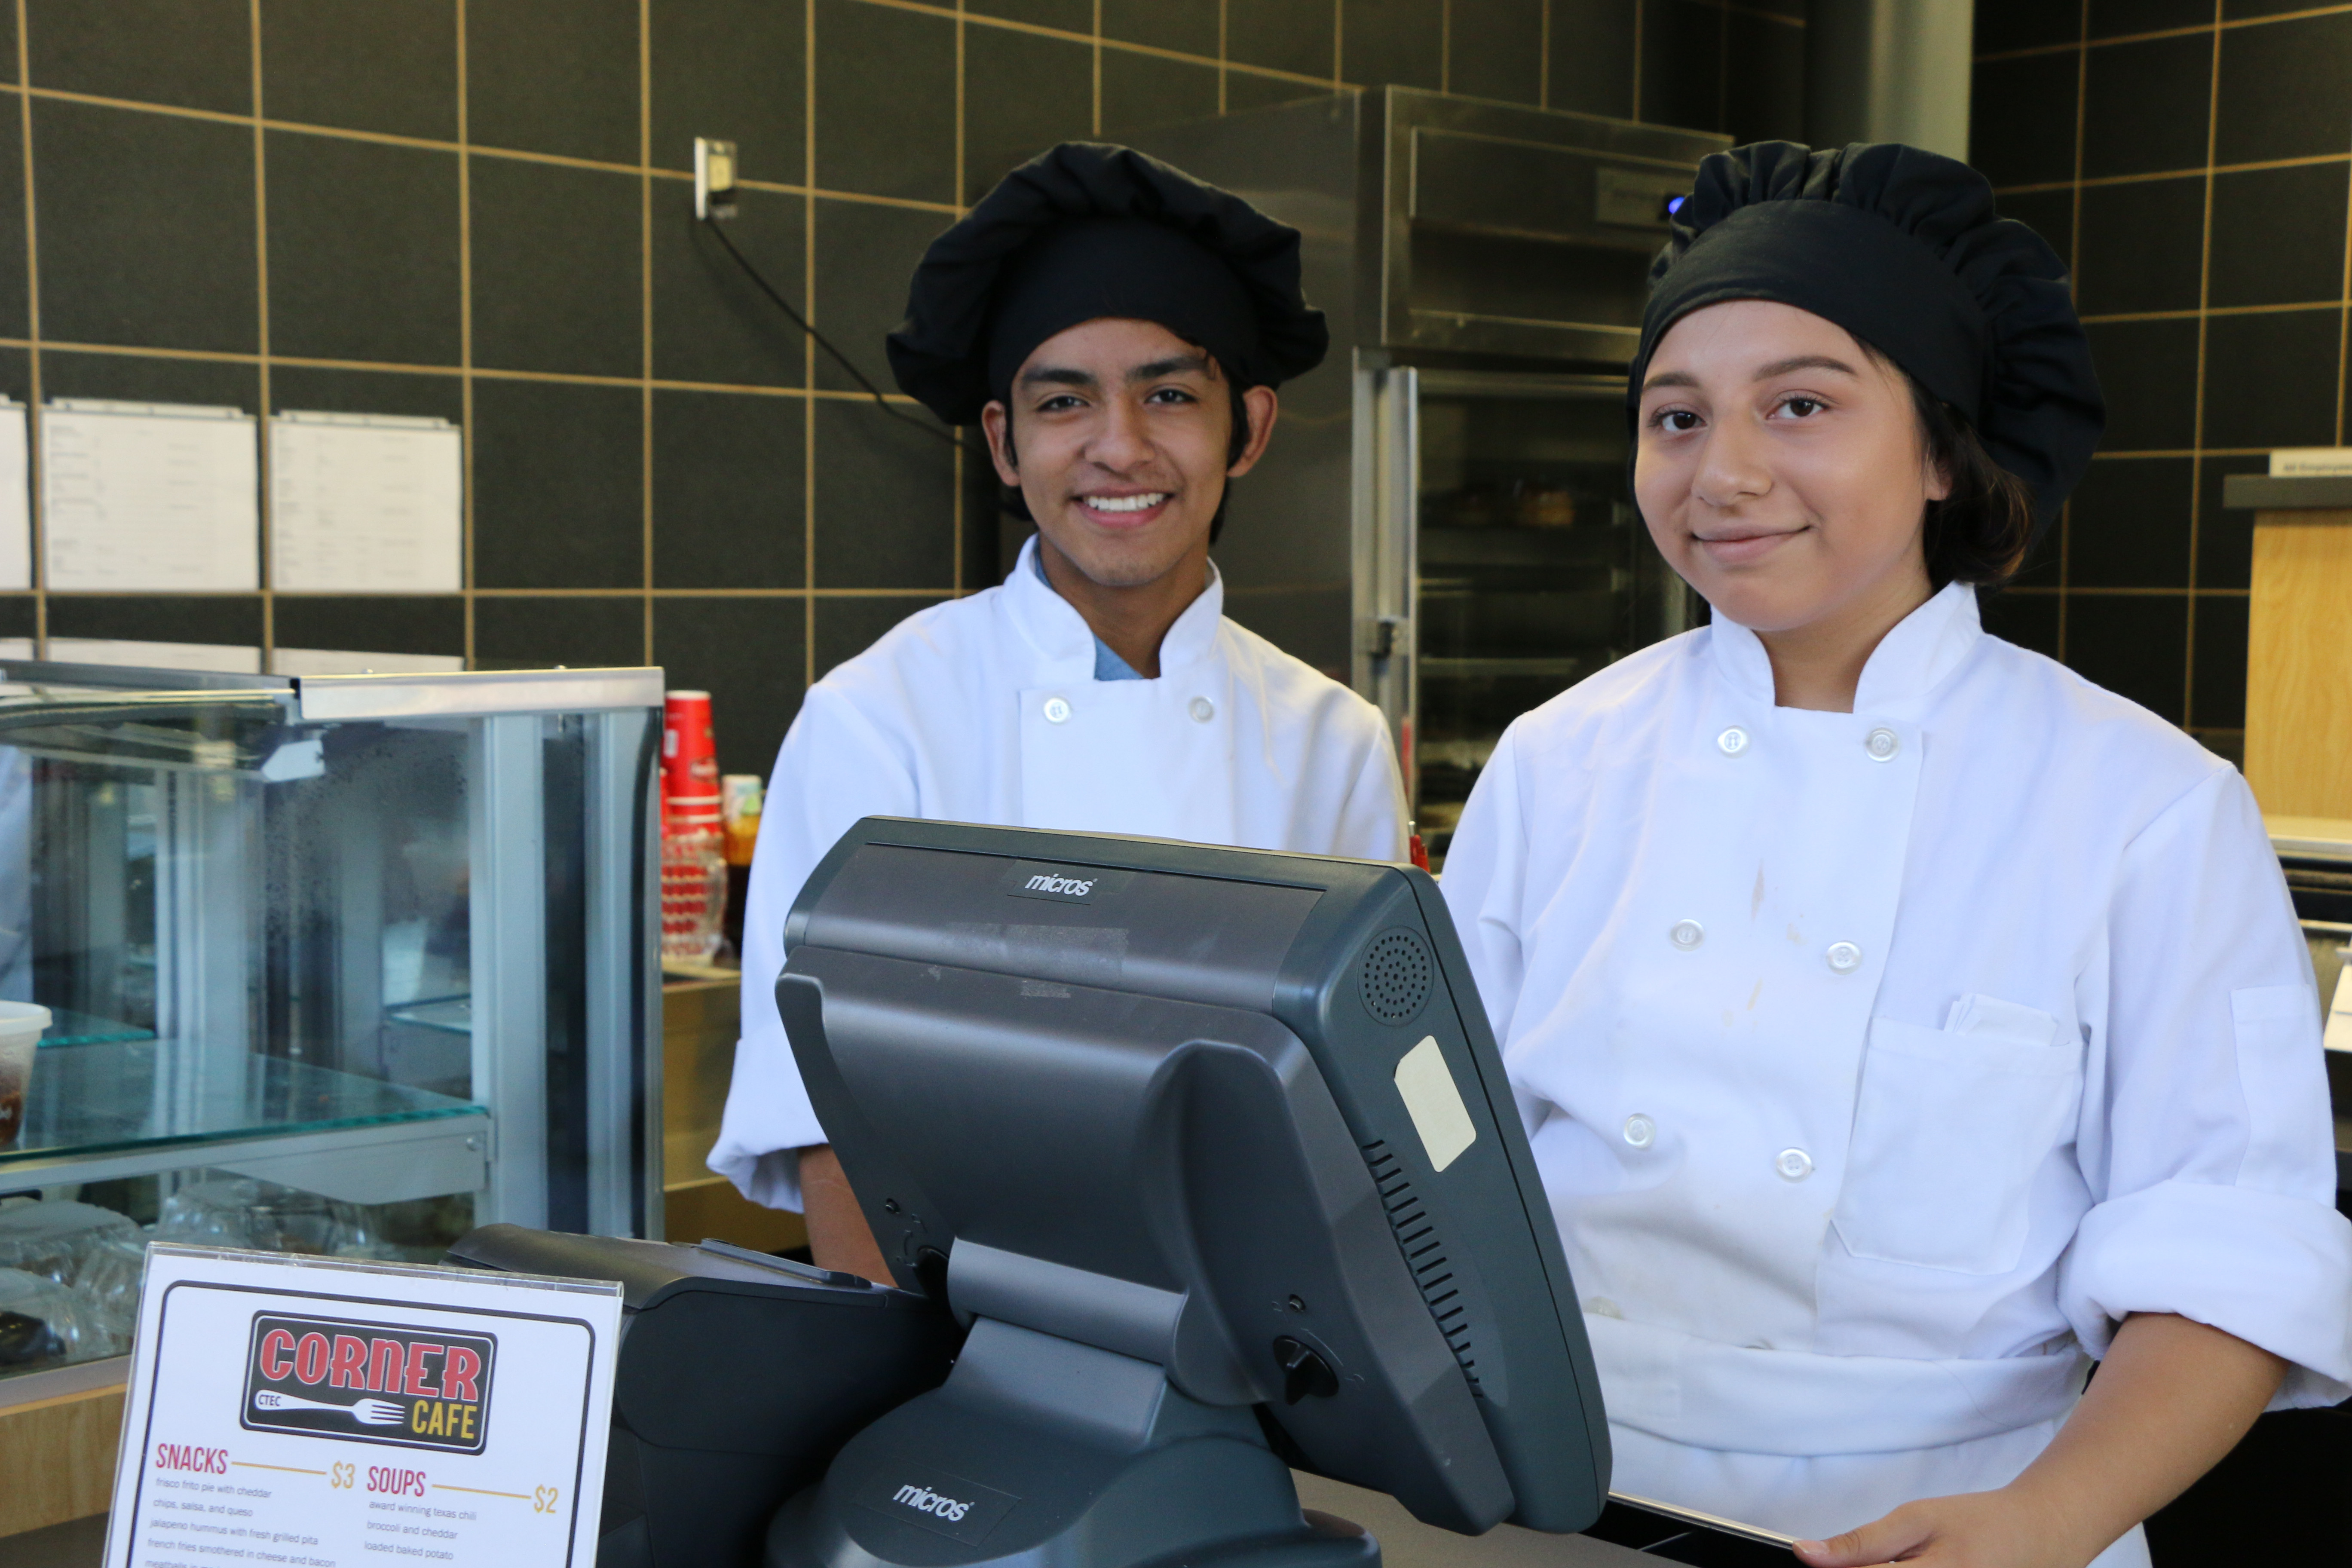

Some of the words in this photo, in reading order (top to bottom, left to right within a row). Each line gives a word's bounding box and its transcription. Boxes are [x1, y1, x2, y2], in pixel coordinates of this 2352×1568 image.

[1025, 873, 1093, 896] micros
[260, 1329, 481, 1402] CORNER
[259, 1394, 282, 1407] CTEC
[411, 1400, 478, 1439] CAFE
[156, 1443, 228, 1474] SNACKS
[331, 1461, 355, 1488] $3
[156, 1477, 180, 1488] frisco
[182, 1480, 199, 1490] frito
[201, 1483, 214, 1492] pie
[217, 1485, 235, 1494] with
[237, 1487, 272, 1498] cheddar
[367, 1466, 426, 1497] SOUPS
[533, 1485, 558, 1513] $2
[153, 1499, 178, 1509] chips,
[181, 1502, 206, 1512] salsa,
[208, 1505, 225, 1513] and
[227, 1507, 253, 1516] queso
[369, 1501, 395, 1510] award
[398, 1504, 431, 1517] winning
[434, 1508, 456, 1518] texas
[459, 1511, 477, 1520] chili
[893, 1485, 969, 1521] micros
[150, 1519, 188, 1529] jalapeno
[190, 1522, 228, 1534] hummus
[230, 1527, 247, 1536] with
[249, 1529, 271, 1539] fresh
[273, 1532, 300, 1542] grilled
[302, 1535, 318, 1545] pita
[367, 1520, 401, 1532] broccoli
[403, 1526, 420, 1535] and
[422, 1528, 458, 1539] cheddar
[148, 1538, 175, 1548] french
[178, 1541, 196, 1551] fries
[199, 1546, 244, 1557] smothered
[247, 1550, 254, 1558] in
[257, 1552, 287, 1562] cheese
[289, 1555, 306, 1565] and
[309, 1557, 336, 1568] bacon
[364, 1540, 394, 1552] loaded
[396, 1544, 423, 1556] baked
[425, 1549, 453, 1560] potato
